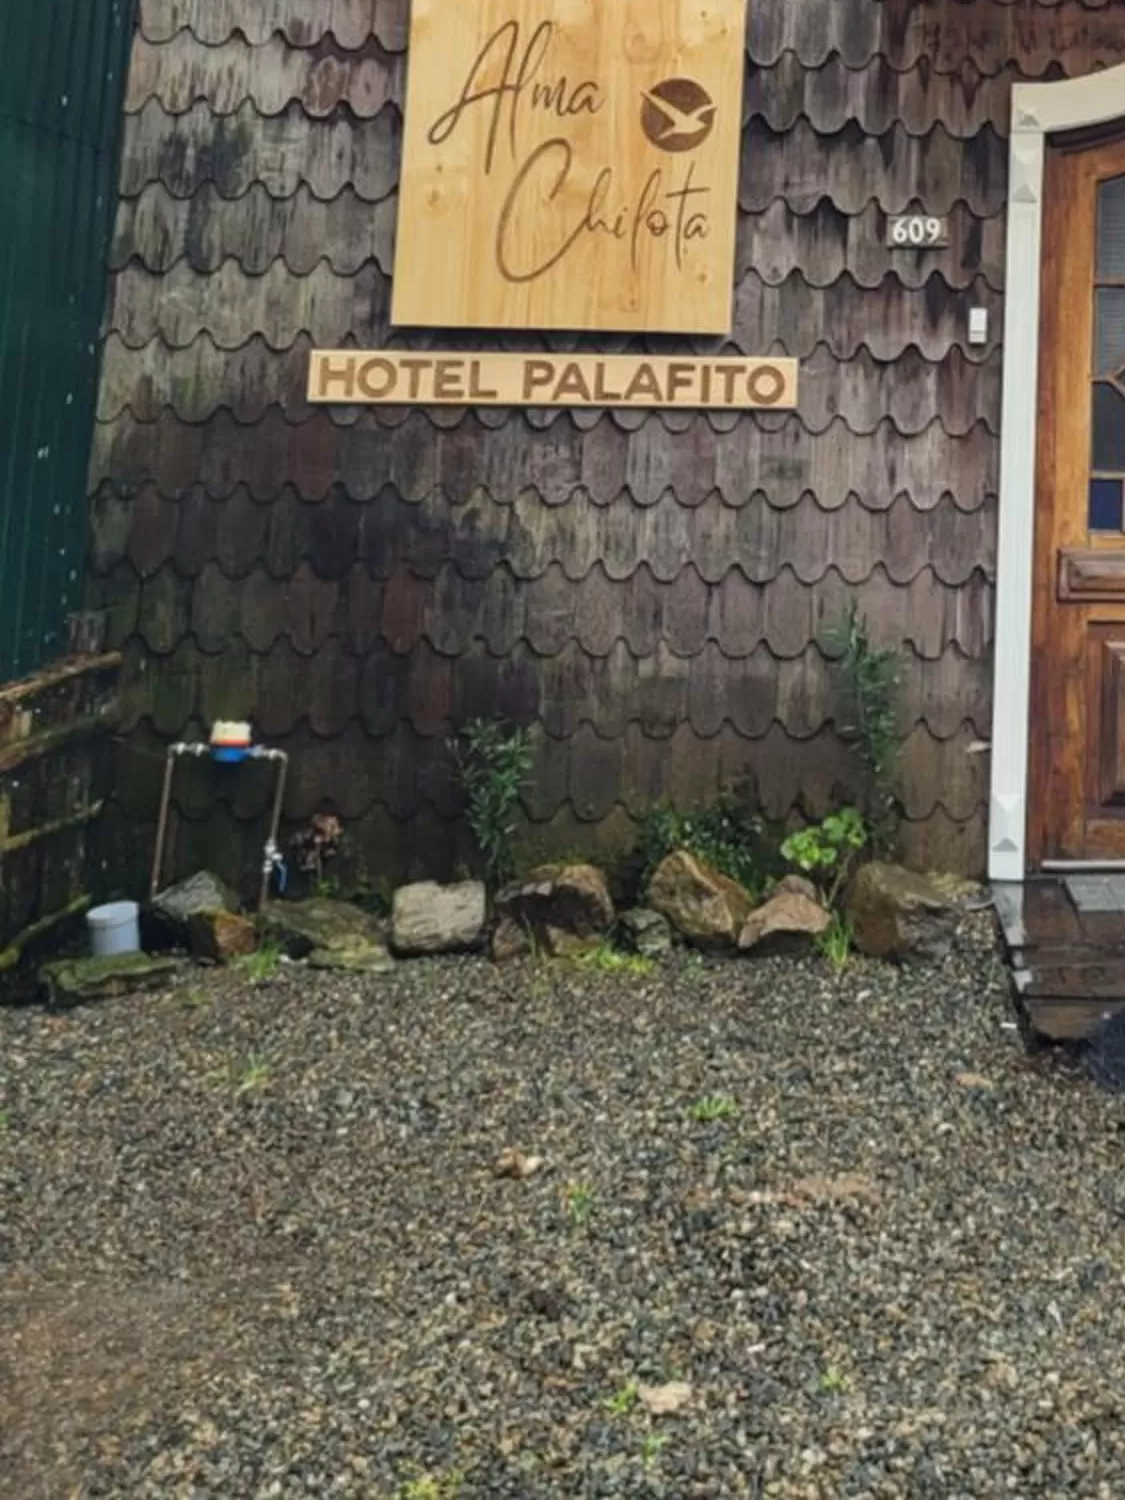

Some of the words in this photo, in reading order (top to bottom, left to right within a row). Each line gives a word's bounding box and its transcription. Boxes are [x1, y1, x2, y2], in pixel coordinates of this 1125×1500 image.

[428, 20, 604, 177] Alma
[495, 137, 711, 283] Chilota
[893, 216, 941, 244] 609
[318, 357, 498, 399] HOTEL
[522, 360, 786, 405] PALAFITO
